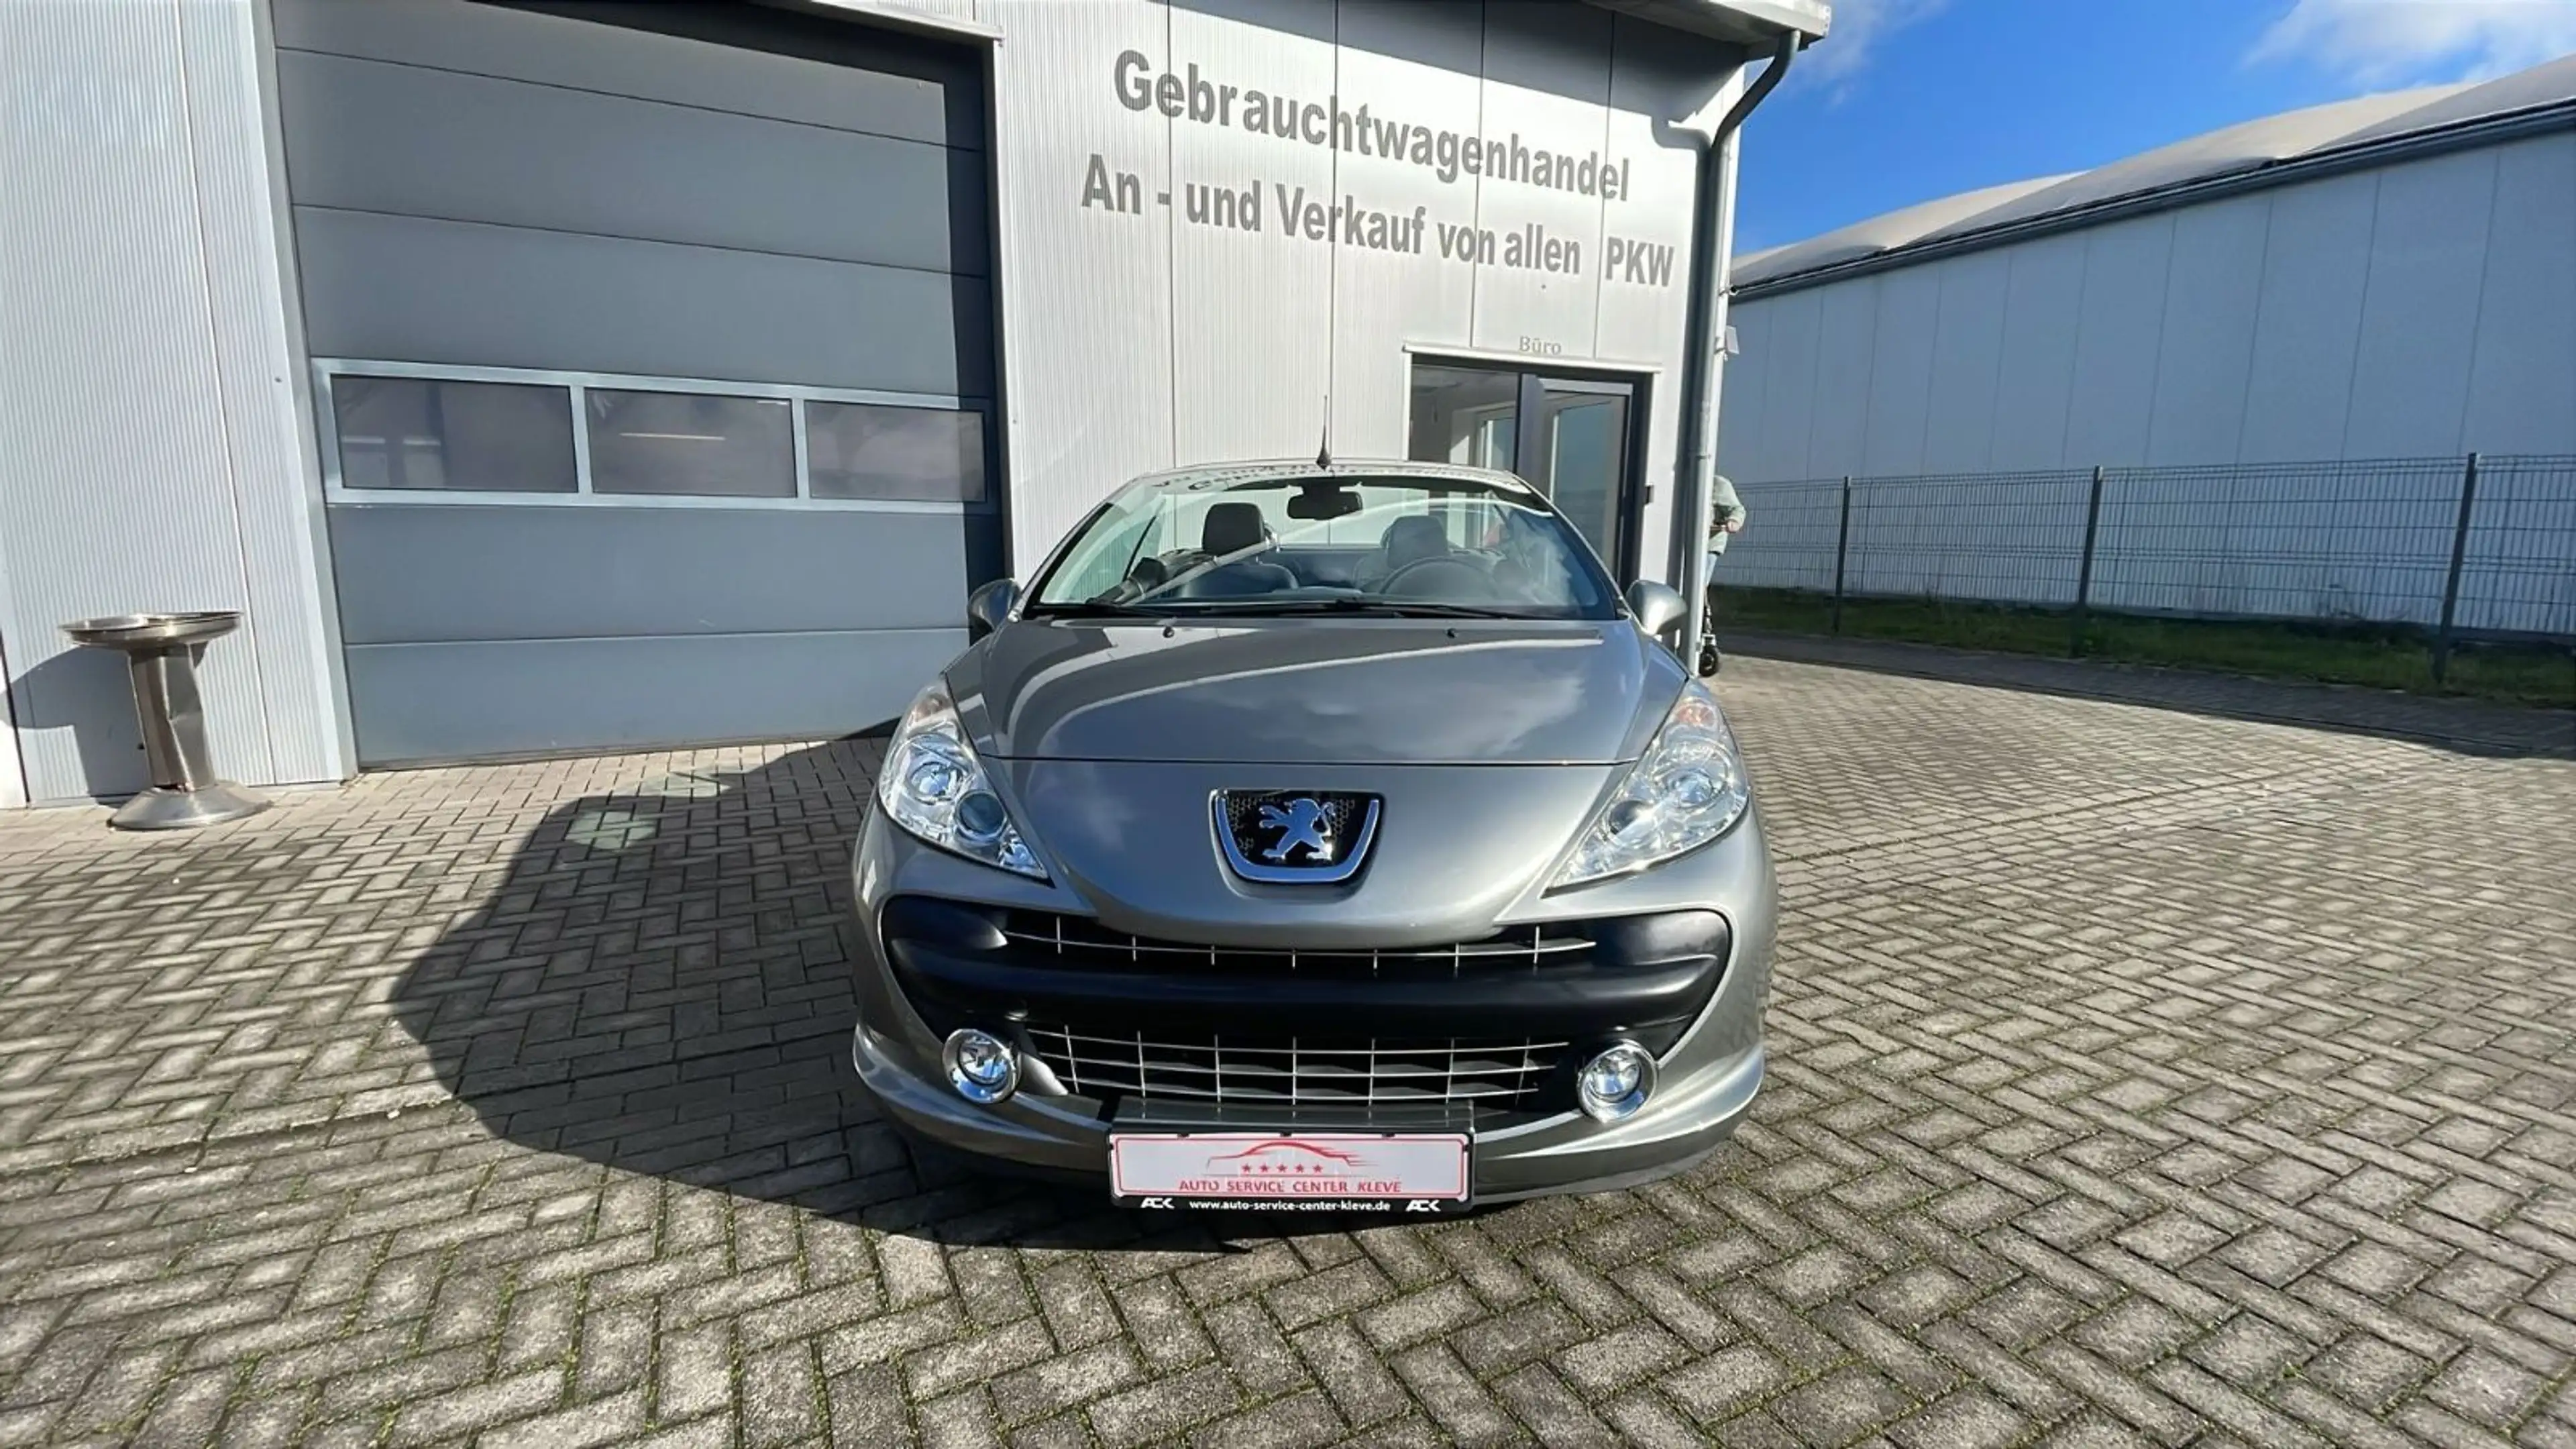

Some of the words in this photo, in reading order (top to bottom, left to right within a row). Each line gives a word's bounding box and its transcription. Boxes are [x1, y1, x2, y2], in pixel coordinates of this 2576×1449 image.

[1114, 50, 1629, 201] Gebrauchtwagenhandel
[1081, 154, 1140, 215] An
[1186, 179, 1261, 231] und
[1275, 183, 1426, 254] Verkauf
[1437, 222, 1495, 266] von
[1504, 223, 1580, 275] allen
[1605, 236, 1674, 287] PKW
[1519, 335, 1562, 355] Büro
[1179, 1180, 1220, 1191] AUTO
[1226, 1180, 1284, 1192] SERVICE
[1293, 1181, 1348, 1193] CENTER
[1357, 1180, 1402, 1193] KLEVE
[1189, 1199, 1391, 1212] www.auto-service-center-kleve.de
